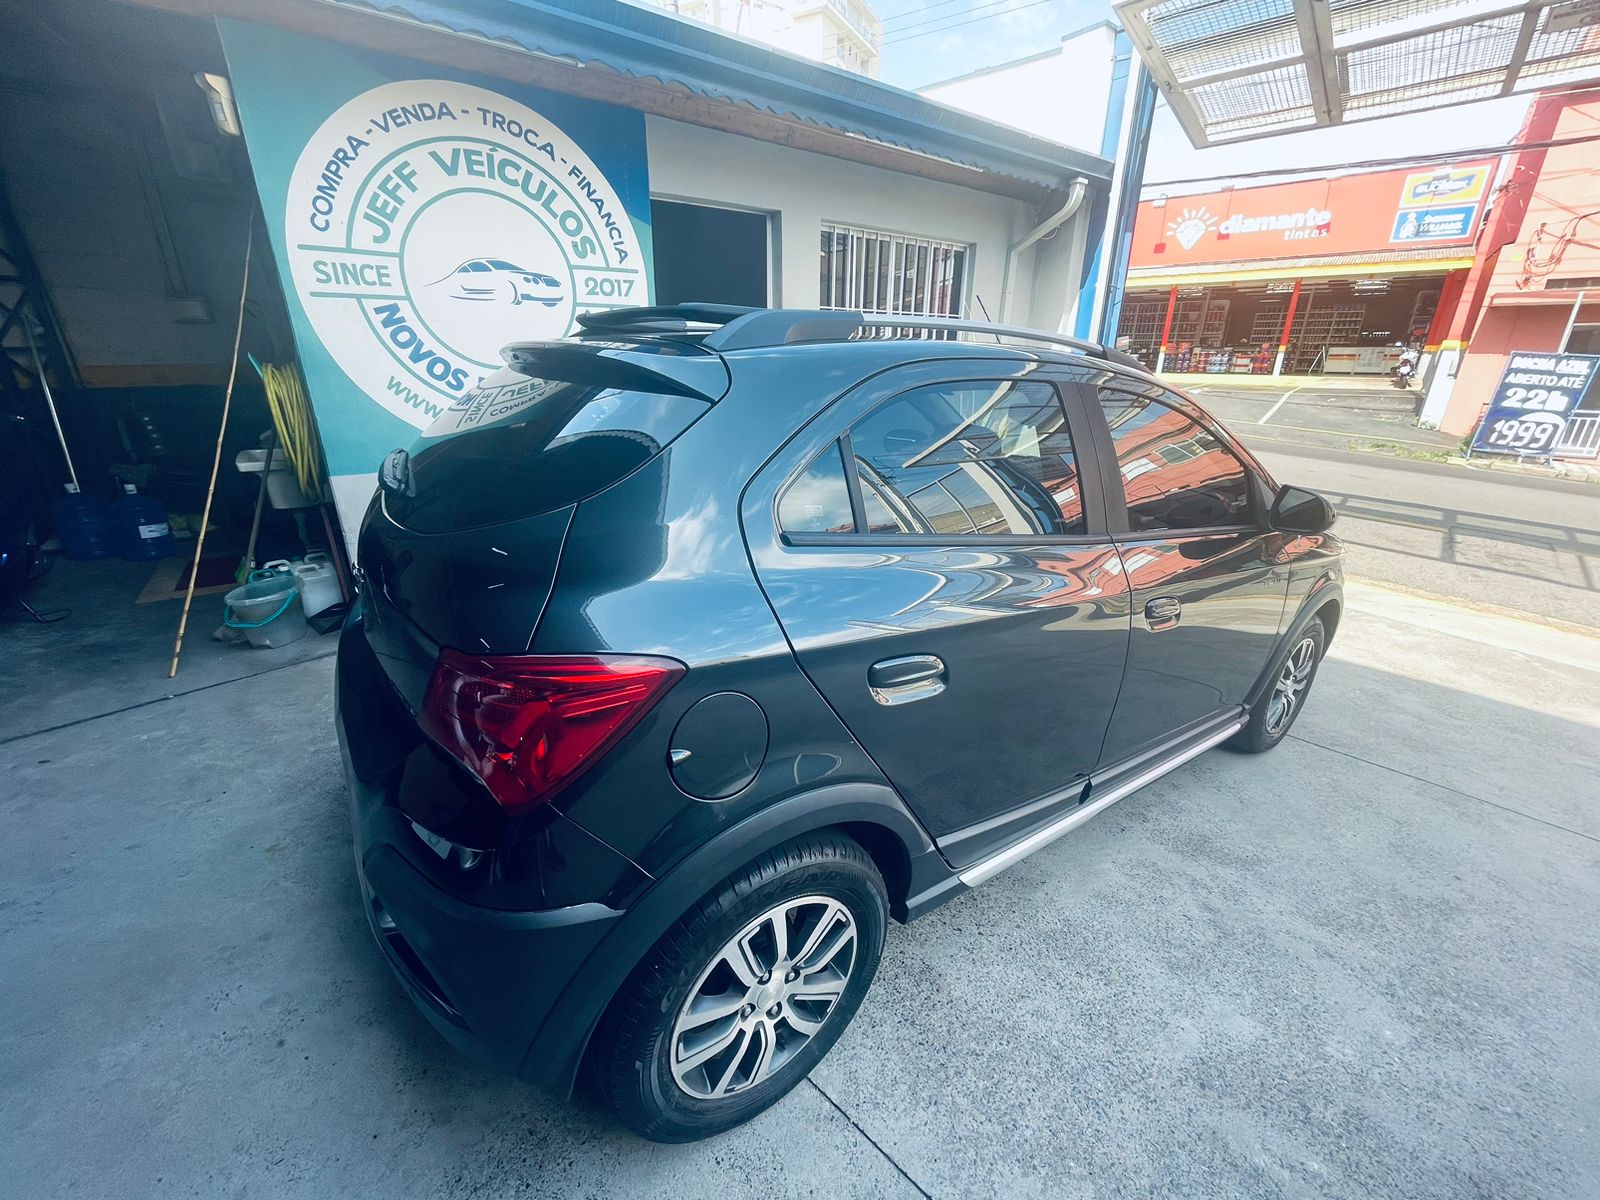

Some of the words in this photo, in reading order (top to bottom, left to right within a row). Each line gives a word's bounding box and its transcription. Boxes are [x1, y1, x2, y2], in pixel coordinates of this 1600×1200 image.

[310, 134, 370, 233] COMPRA
[477, 107, 556, 163] TROCA
[567, 164, 629, 265] FINANCIA
[362, 160, 418, 244] JEFF
[428, 146, 596, 260] VEÍCULOS
[1219, 207, 1332, 234] diamante
[1284, 228, 1329, 240] tintas
[313, 260, 392, 287] SINCE
[584, 277, 635, 298] 2017
[373, 302, 470, 392] NOVOS
[1556, 375, 1586, 388] ATÉ
